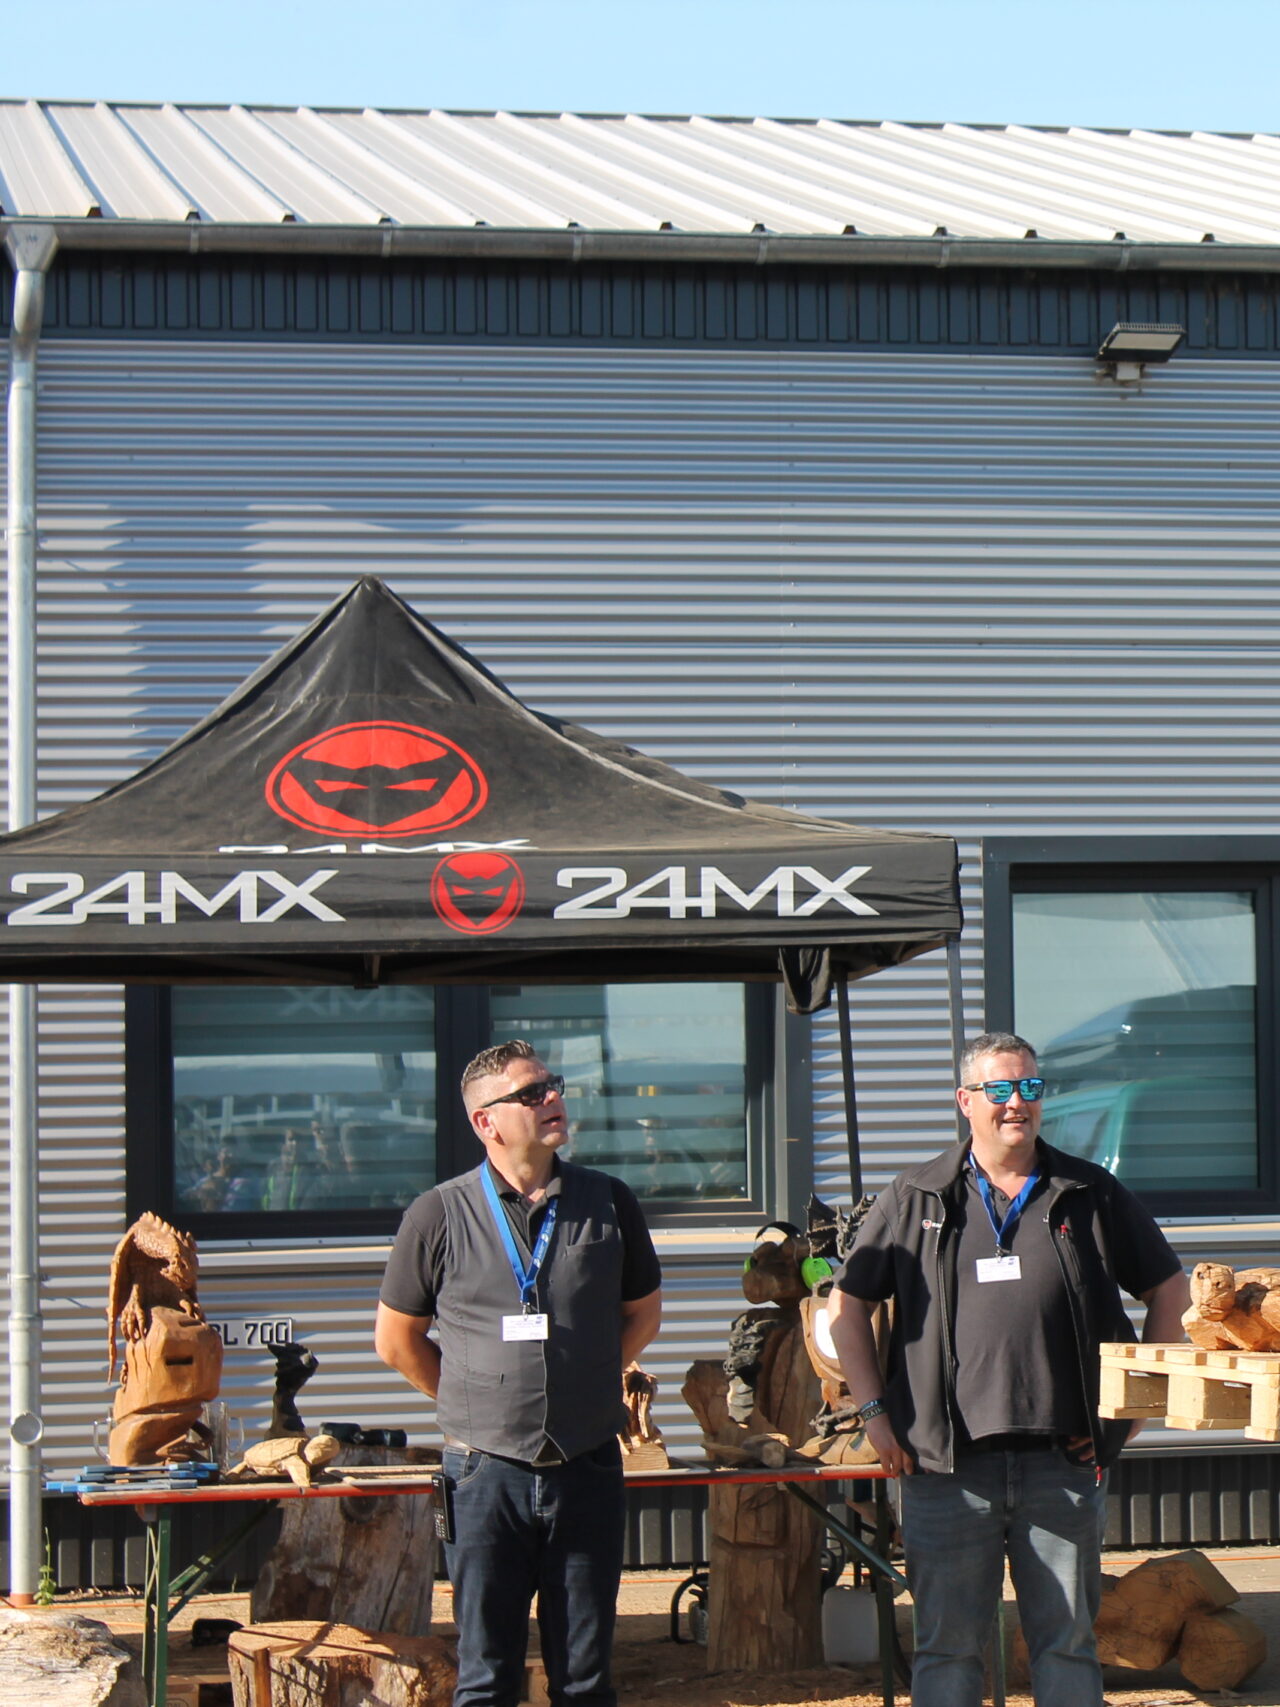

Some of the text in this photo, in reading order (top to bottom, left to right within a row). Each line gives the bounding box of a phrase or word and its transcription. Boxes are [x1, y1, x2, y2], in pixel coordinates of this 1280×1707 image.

[7, 869, 347, 926] 24MX
[553, 866, 880, 919] 24MX
[245, 1322, 289, 1345] 700
